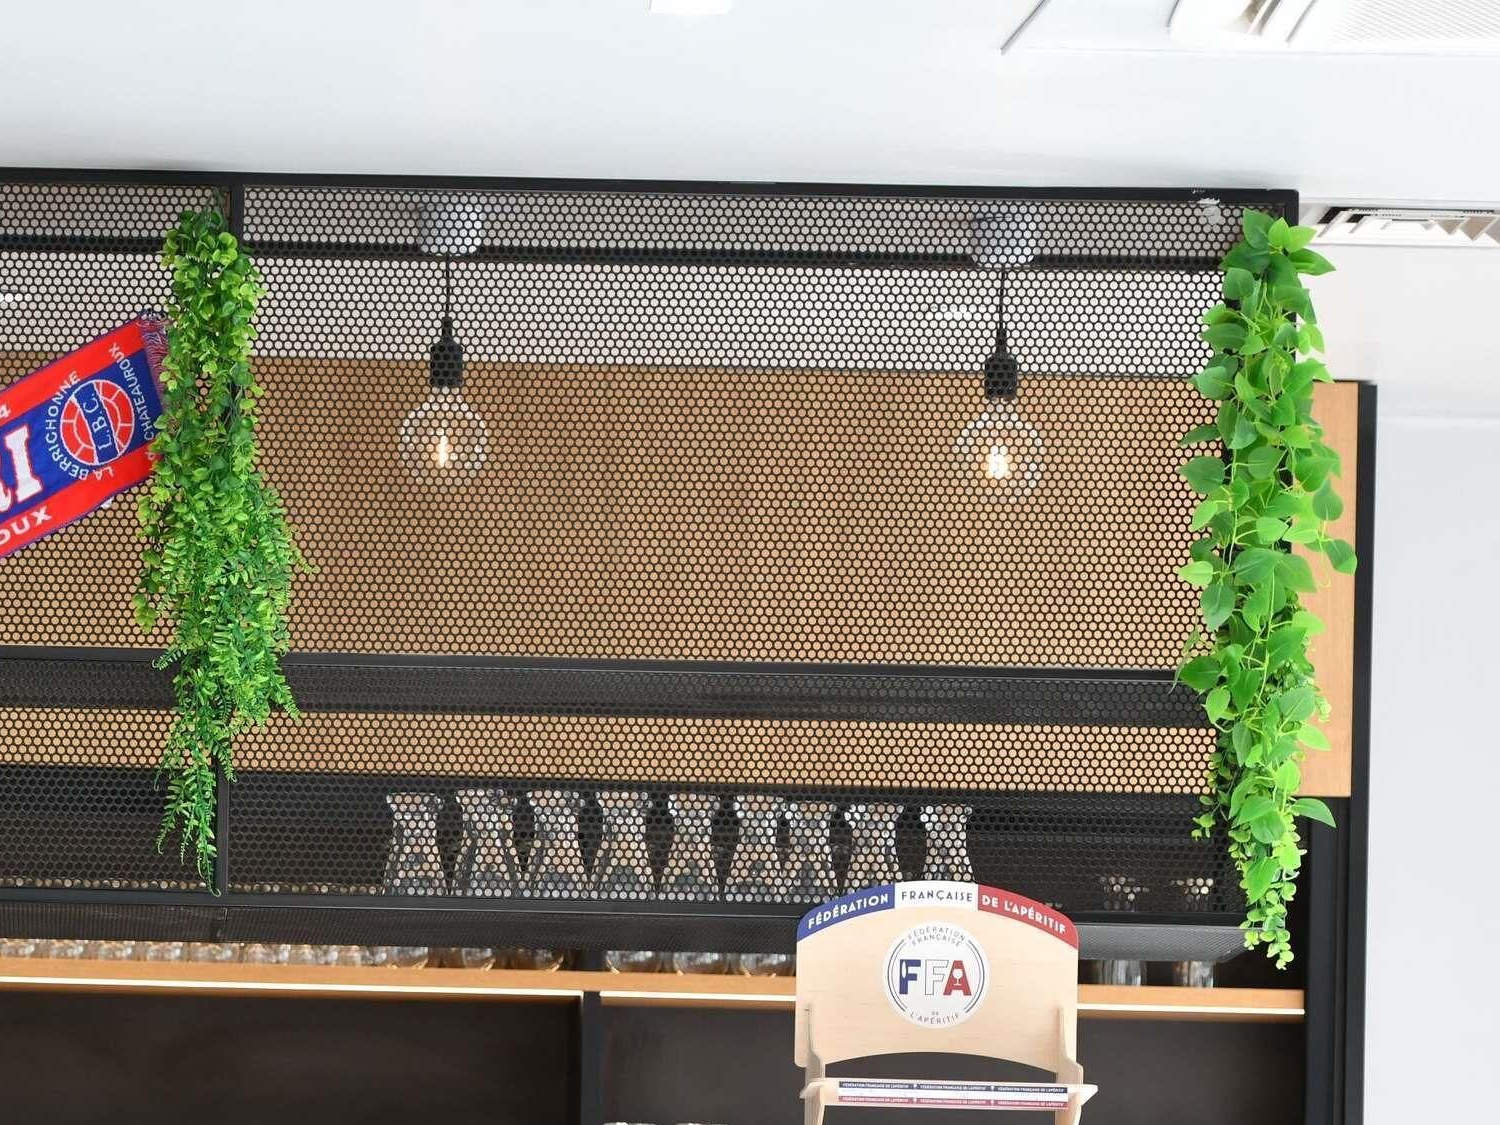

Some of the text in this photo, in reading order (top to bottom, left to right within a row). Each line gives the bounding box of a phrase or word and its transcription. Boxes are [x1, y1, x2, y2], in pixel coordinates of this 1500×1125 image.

[45, 370, 115, 480] LA BERRICHONNE
[108, 341, 155, 440] CHATEAUROUX
[808, 893, 888, 930] FÉDÉRATION
[901, 890, 973, 902] FRANÇAISE
[982, 894, 999, 909] DE
[899, 958, 972, 996] FFA
